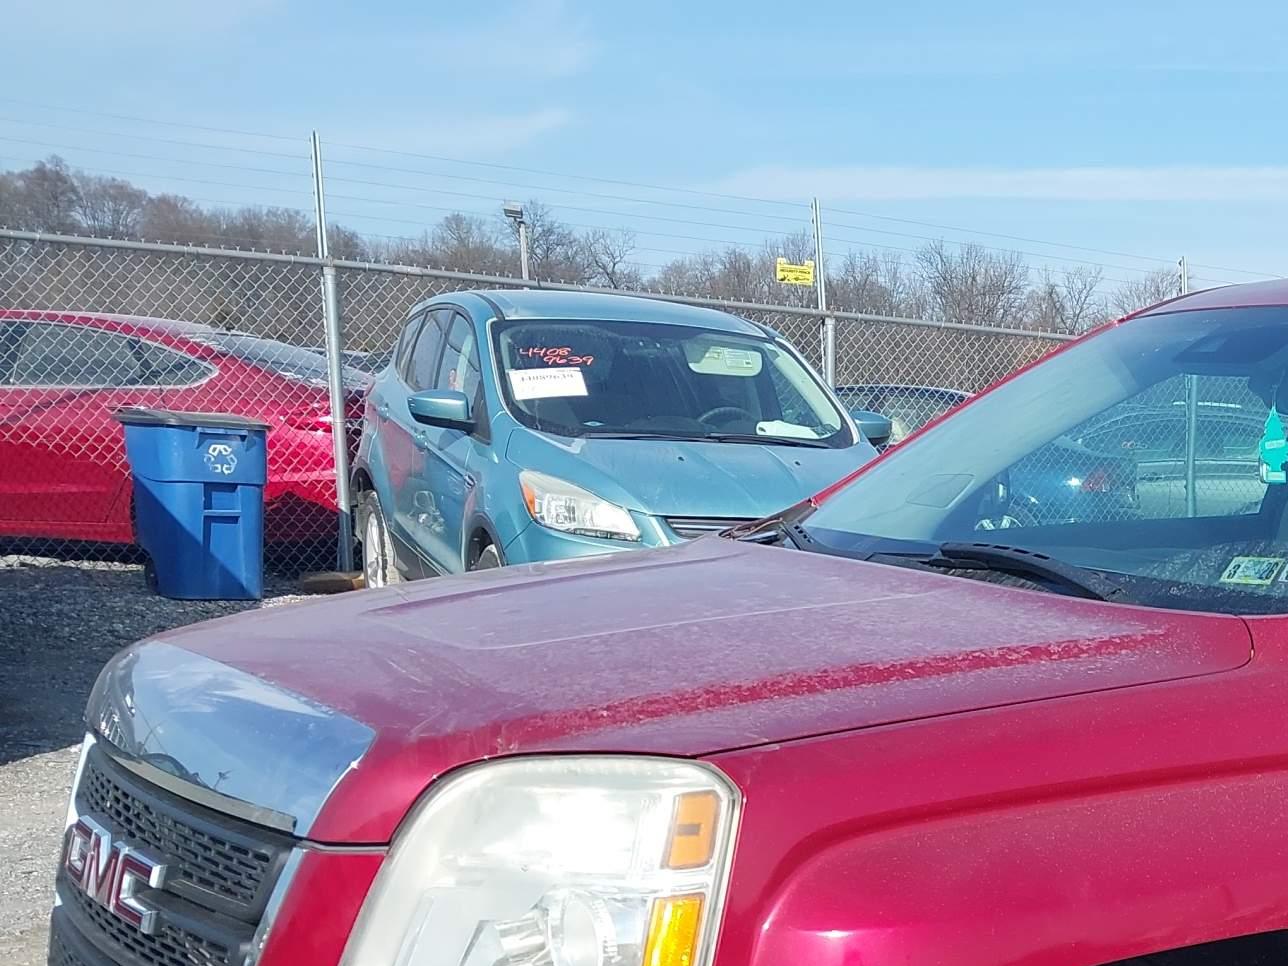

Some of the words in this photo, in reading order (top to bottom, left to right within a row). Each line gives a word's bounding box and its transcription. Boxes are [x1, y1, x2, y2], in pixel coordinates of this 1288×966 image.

[520, 346, 572, 358] 4408
[543, 355, 594, 366] 9639
[1226, 563, 1241, 580] 3
[1257, 561, 1280, 580] 26
[64, 814, 167, 935] GMC
